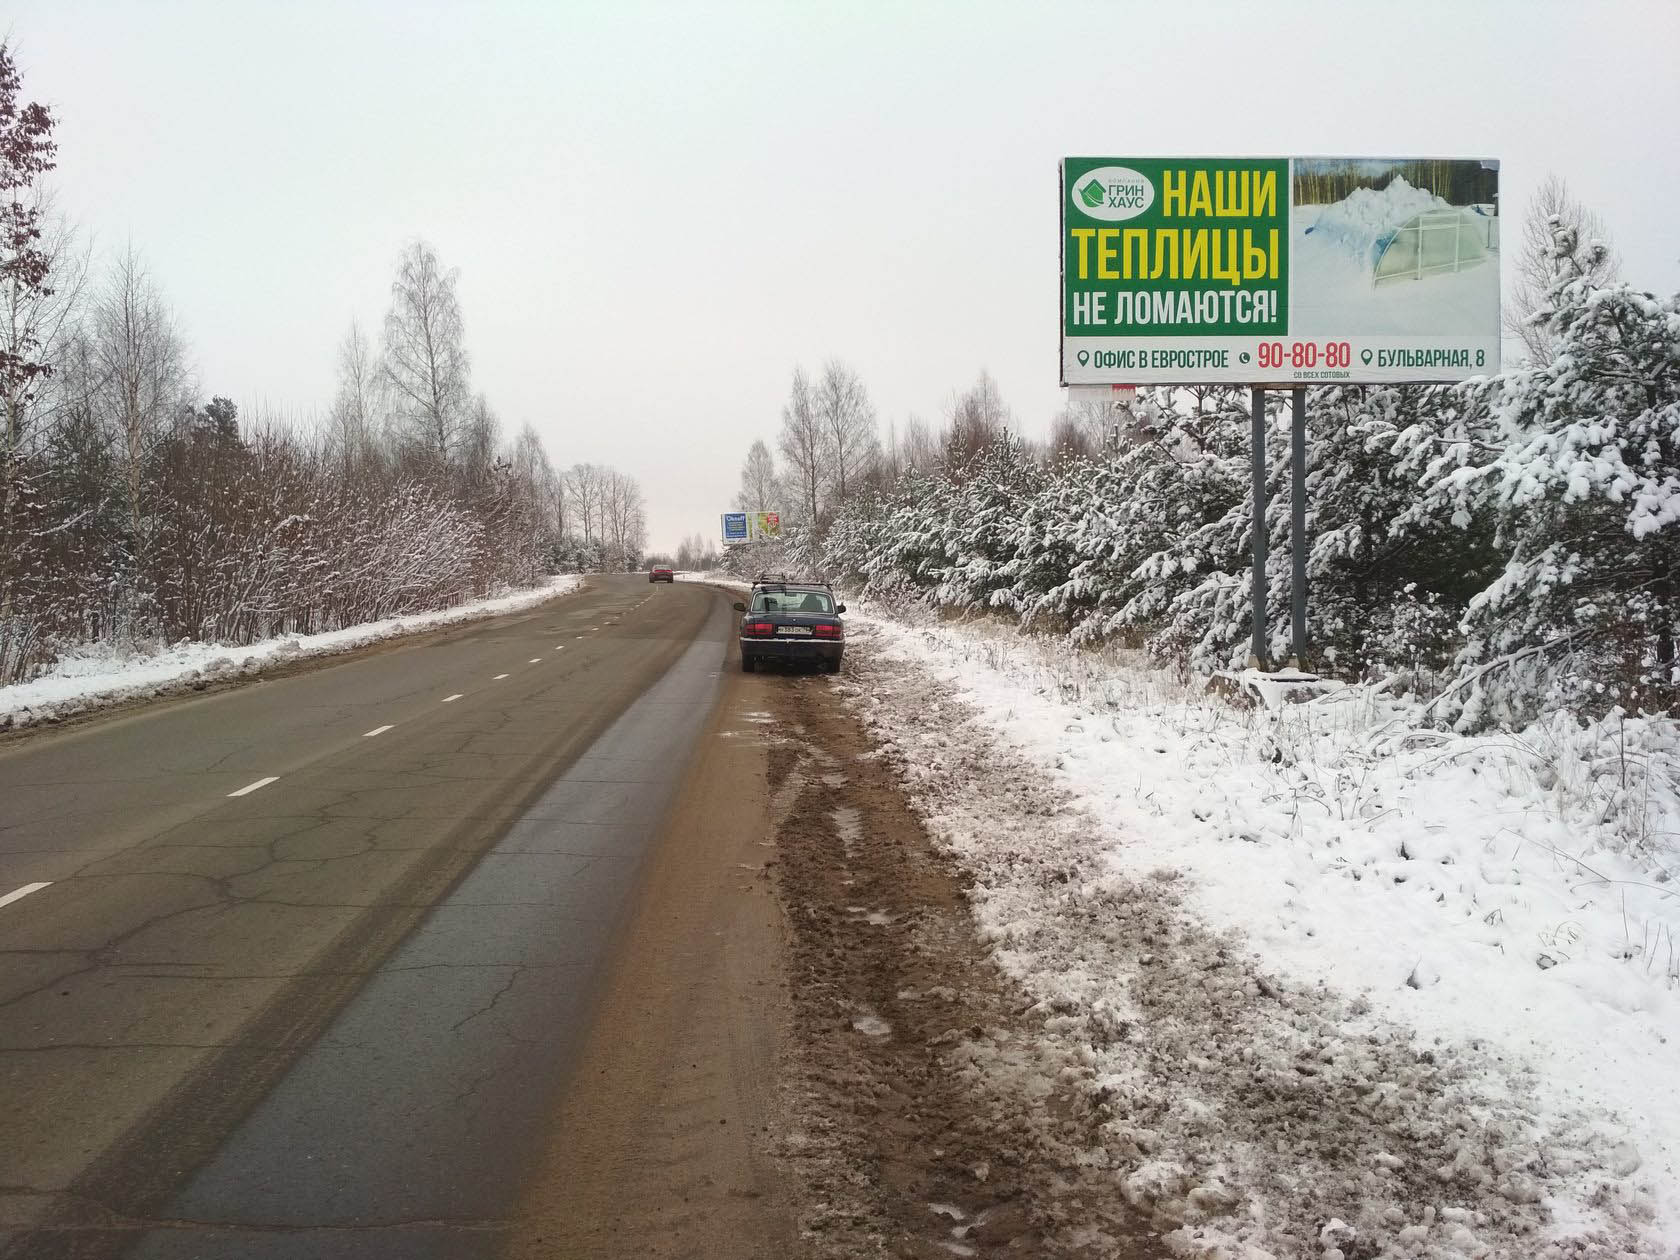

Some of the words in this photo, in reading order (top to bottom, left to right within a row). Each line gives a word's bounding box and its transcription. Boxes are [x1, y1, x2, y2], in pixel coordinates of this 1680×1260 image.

[1108, 185, 1144, 197] ГРИН
[1162, 170, 1277, 217] НАШИ
[1108, 197, 1144, 209] ХАУС
[1071, 228, 1279, 286] ТЕПЛИЦЫ
[1073, 291, 1107, 325] НЕ
[1114, 290, 1278, 325] ЛОМАЮТСЯ!
[1094, 350, 1136, 369] ОФИС
[1139, 350, 1148, 368] В
[1151, 350, 1229, 368] ЕВРОСТРОЕ
[1258, 342, 1351, 369] 90-80-80
[1378, 349, 1473, 371] БУЛЬВАРНАЯ,
[1476, 349, 1485, 367] 8
[1293, 371, 1303, 379] СО
[1303, 371, 1319, 379] ВСЕХ
[1320, 371, 1350, 379] СОТОВЫХ
